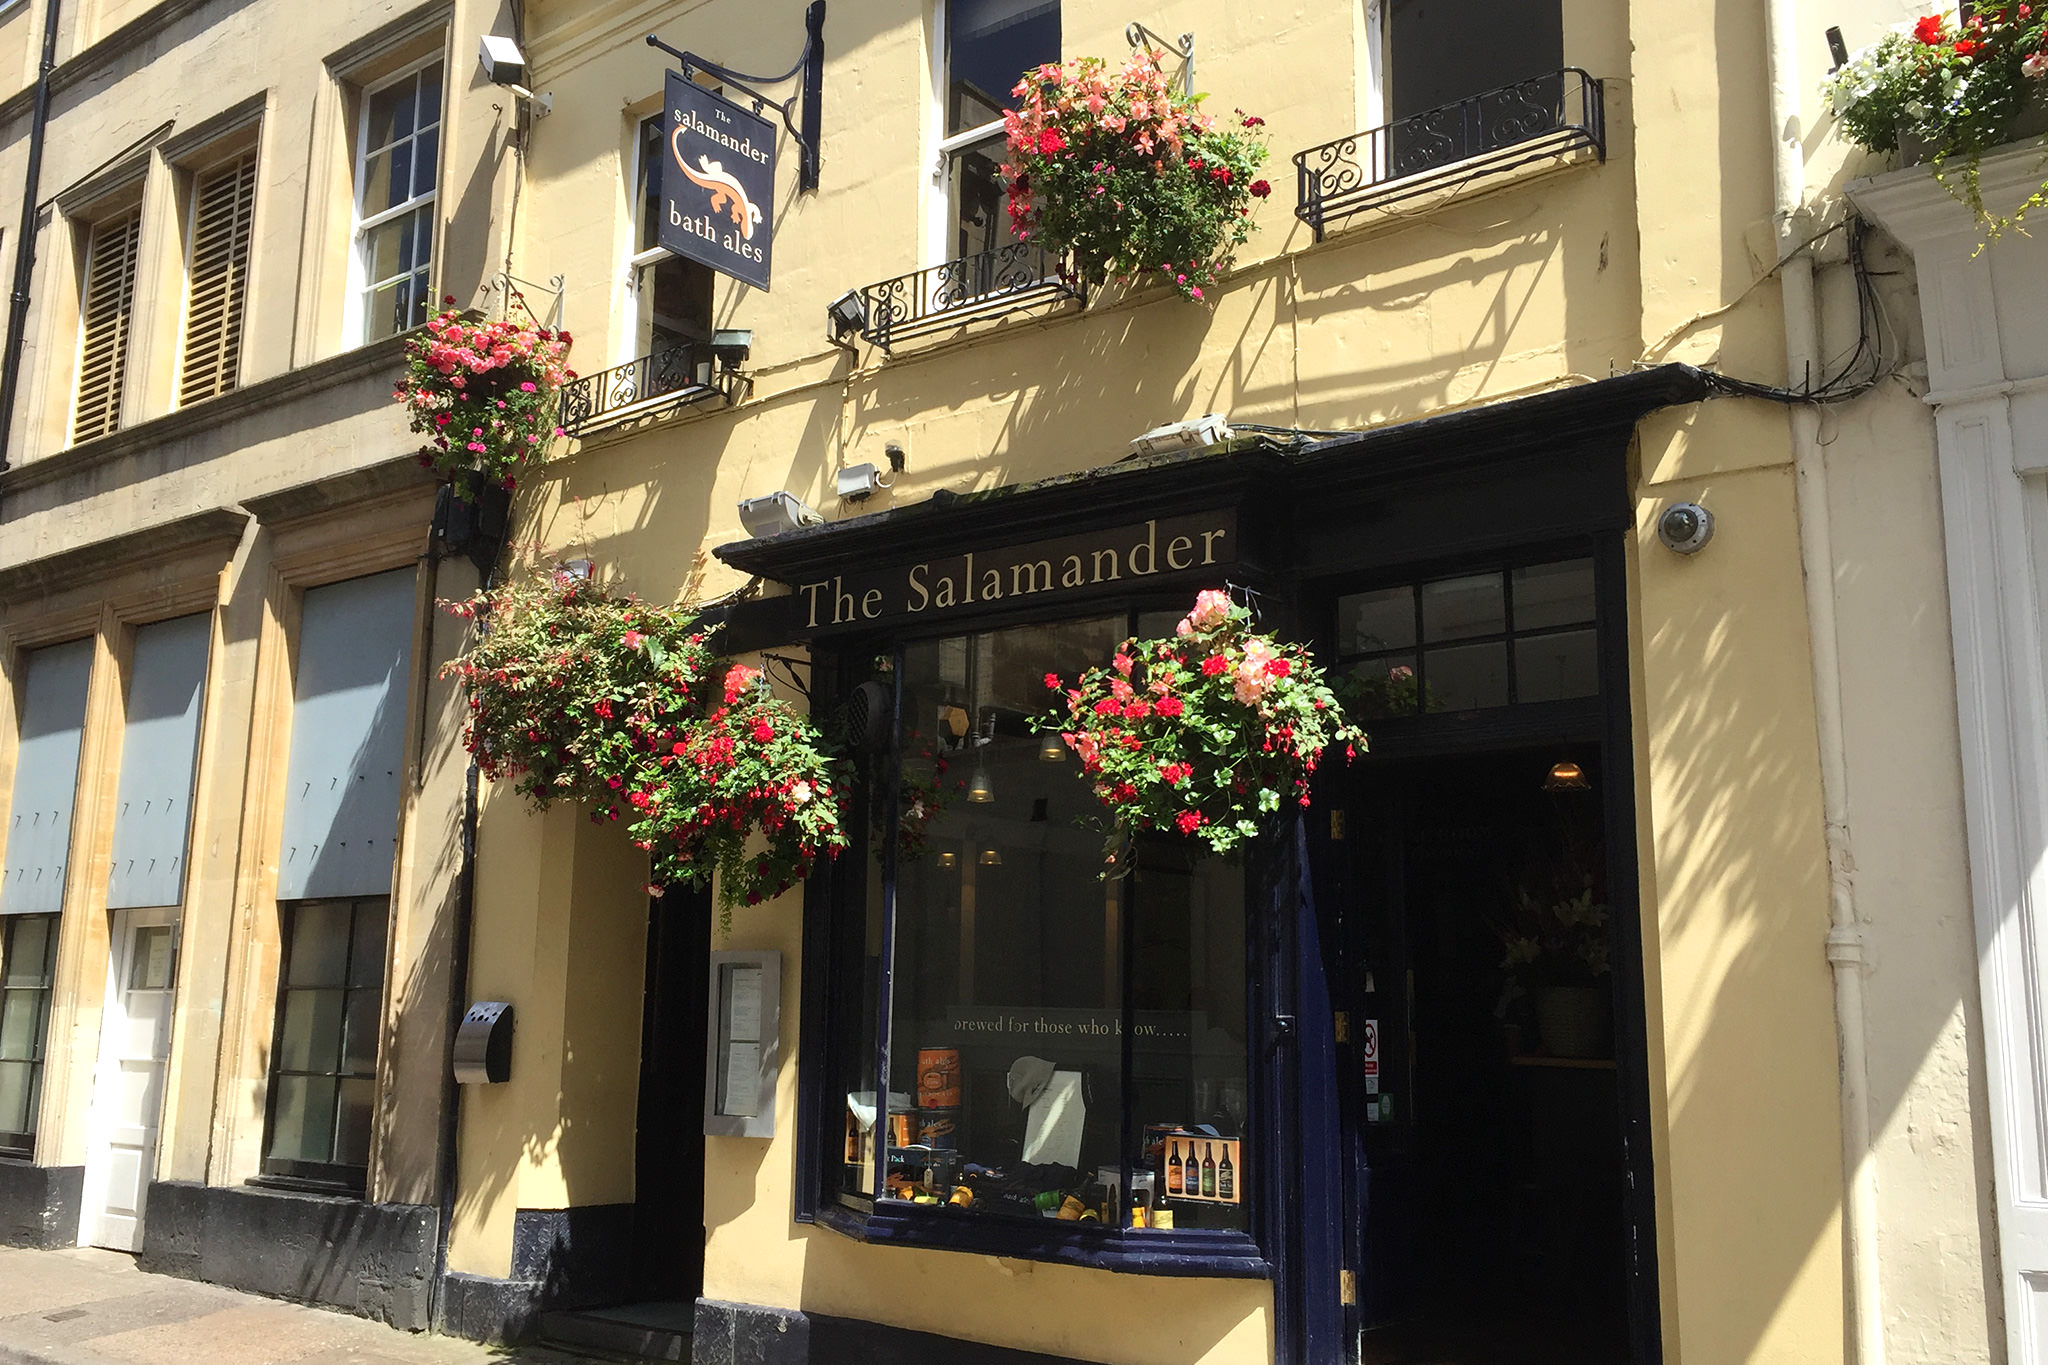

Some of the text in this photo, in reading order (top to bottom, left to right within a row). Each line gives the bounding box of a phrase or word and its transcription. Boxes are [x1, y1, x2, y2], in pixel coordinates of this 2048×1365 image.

[673, 106, 769, 166] salamander
[715, 109, 732, 124] The
[669, 200, 764, 264] bath ales
[799, 520, 1226, 629] The Salamander
[1008, 1016, 1029, 1033] for
[1034, 1016, 1073, 1034] those
[1078, 1018, 1109, 1035] who
[1115, 1018, 1188, 1037] kow.....
